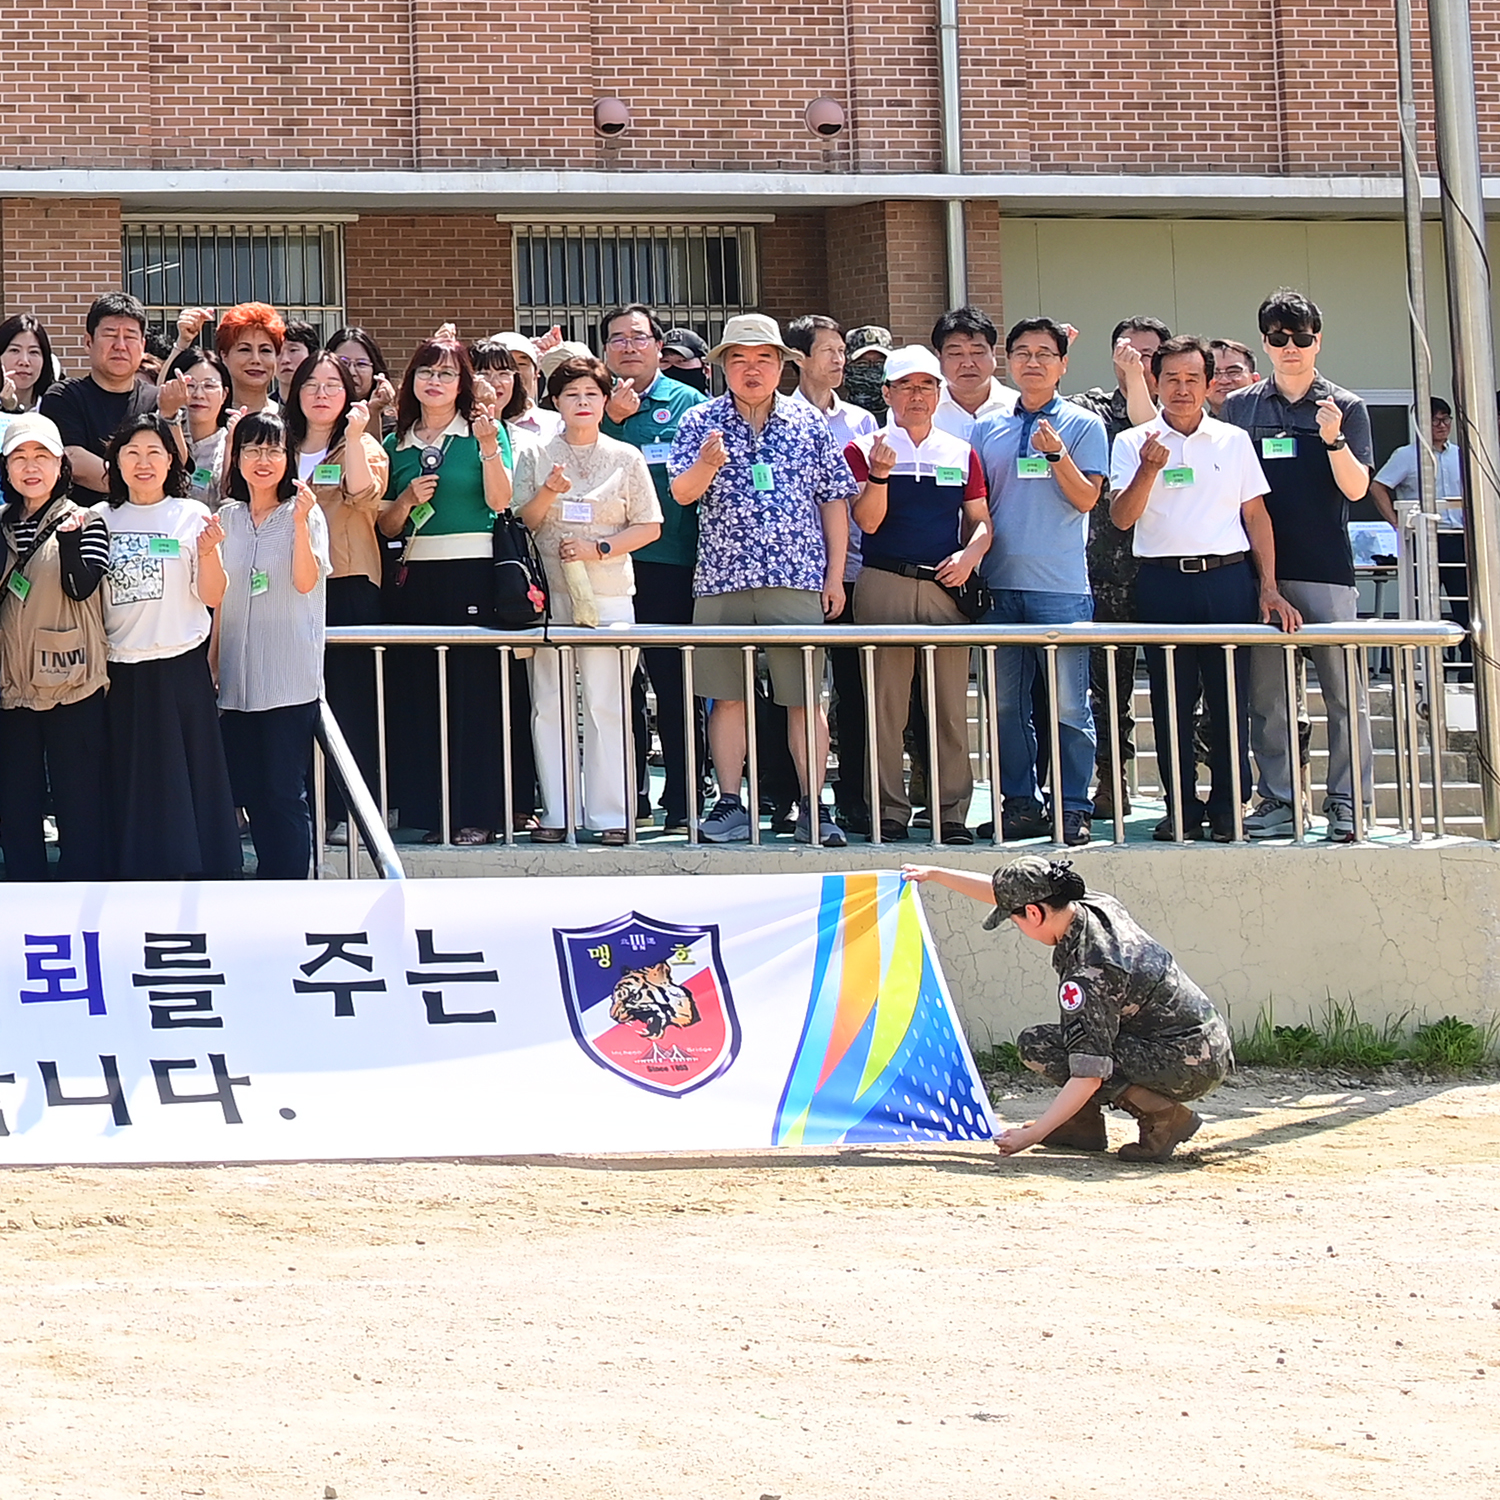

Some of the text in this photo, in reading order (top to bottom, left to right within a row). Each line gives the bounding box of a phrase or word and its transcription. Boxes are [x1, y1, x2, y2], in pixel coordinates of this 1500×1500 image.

[293, 928, 500, 1025] 주는
[586, 943, 696, 968] 맹 호
